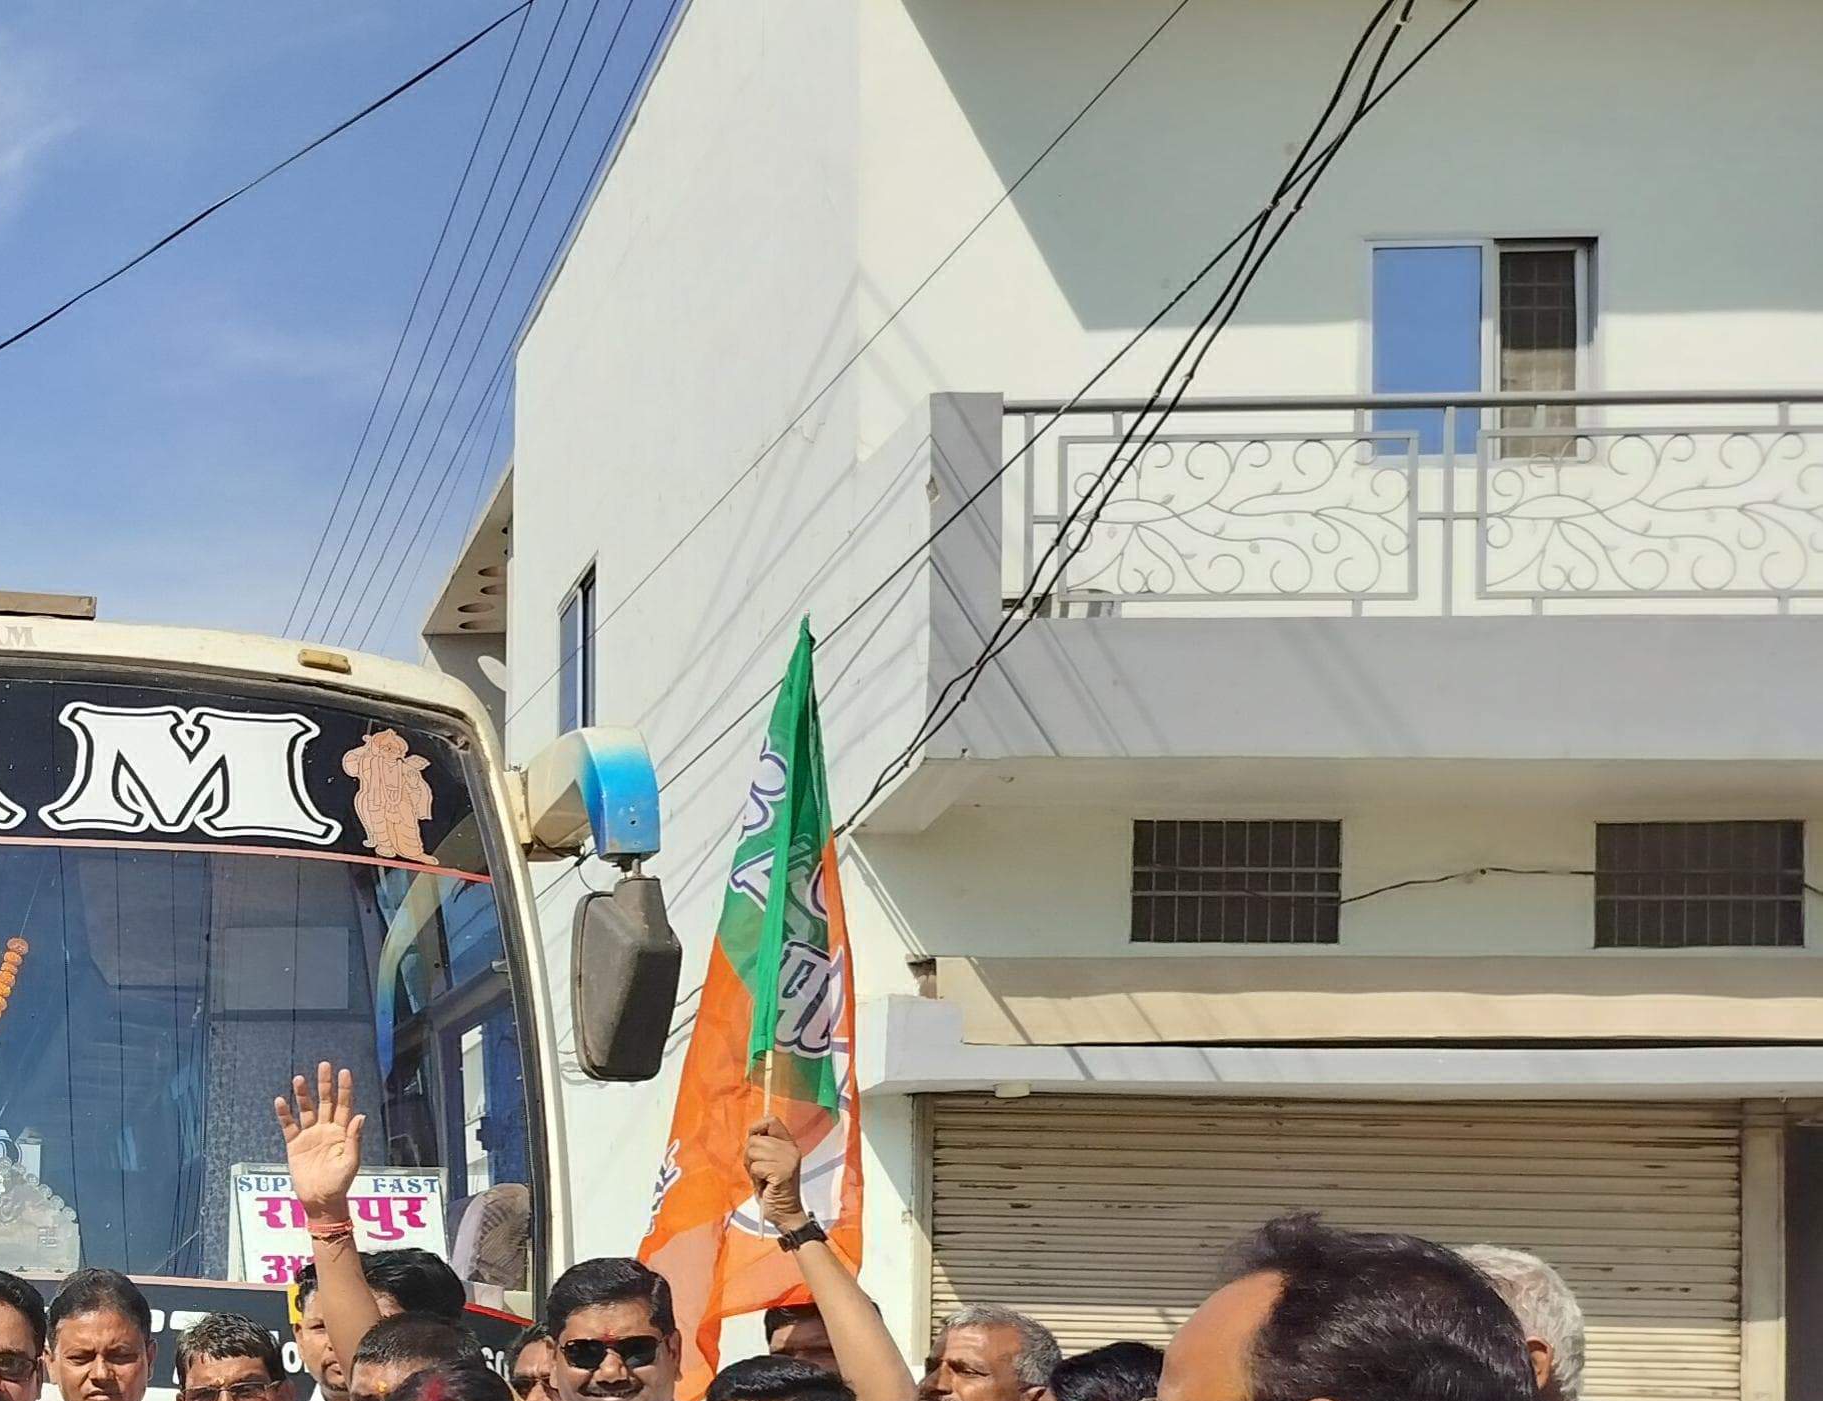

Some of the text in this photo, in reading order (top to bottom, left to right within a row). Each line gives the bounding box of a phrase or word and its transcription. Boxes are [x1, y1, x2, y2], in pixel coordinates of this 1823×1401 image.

[238, 1176, 439, 1194] SUP FAST
[255, 1196, 428, 1241] रापुर
